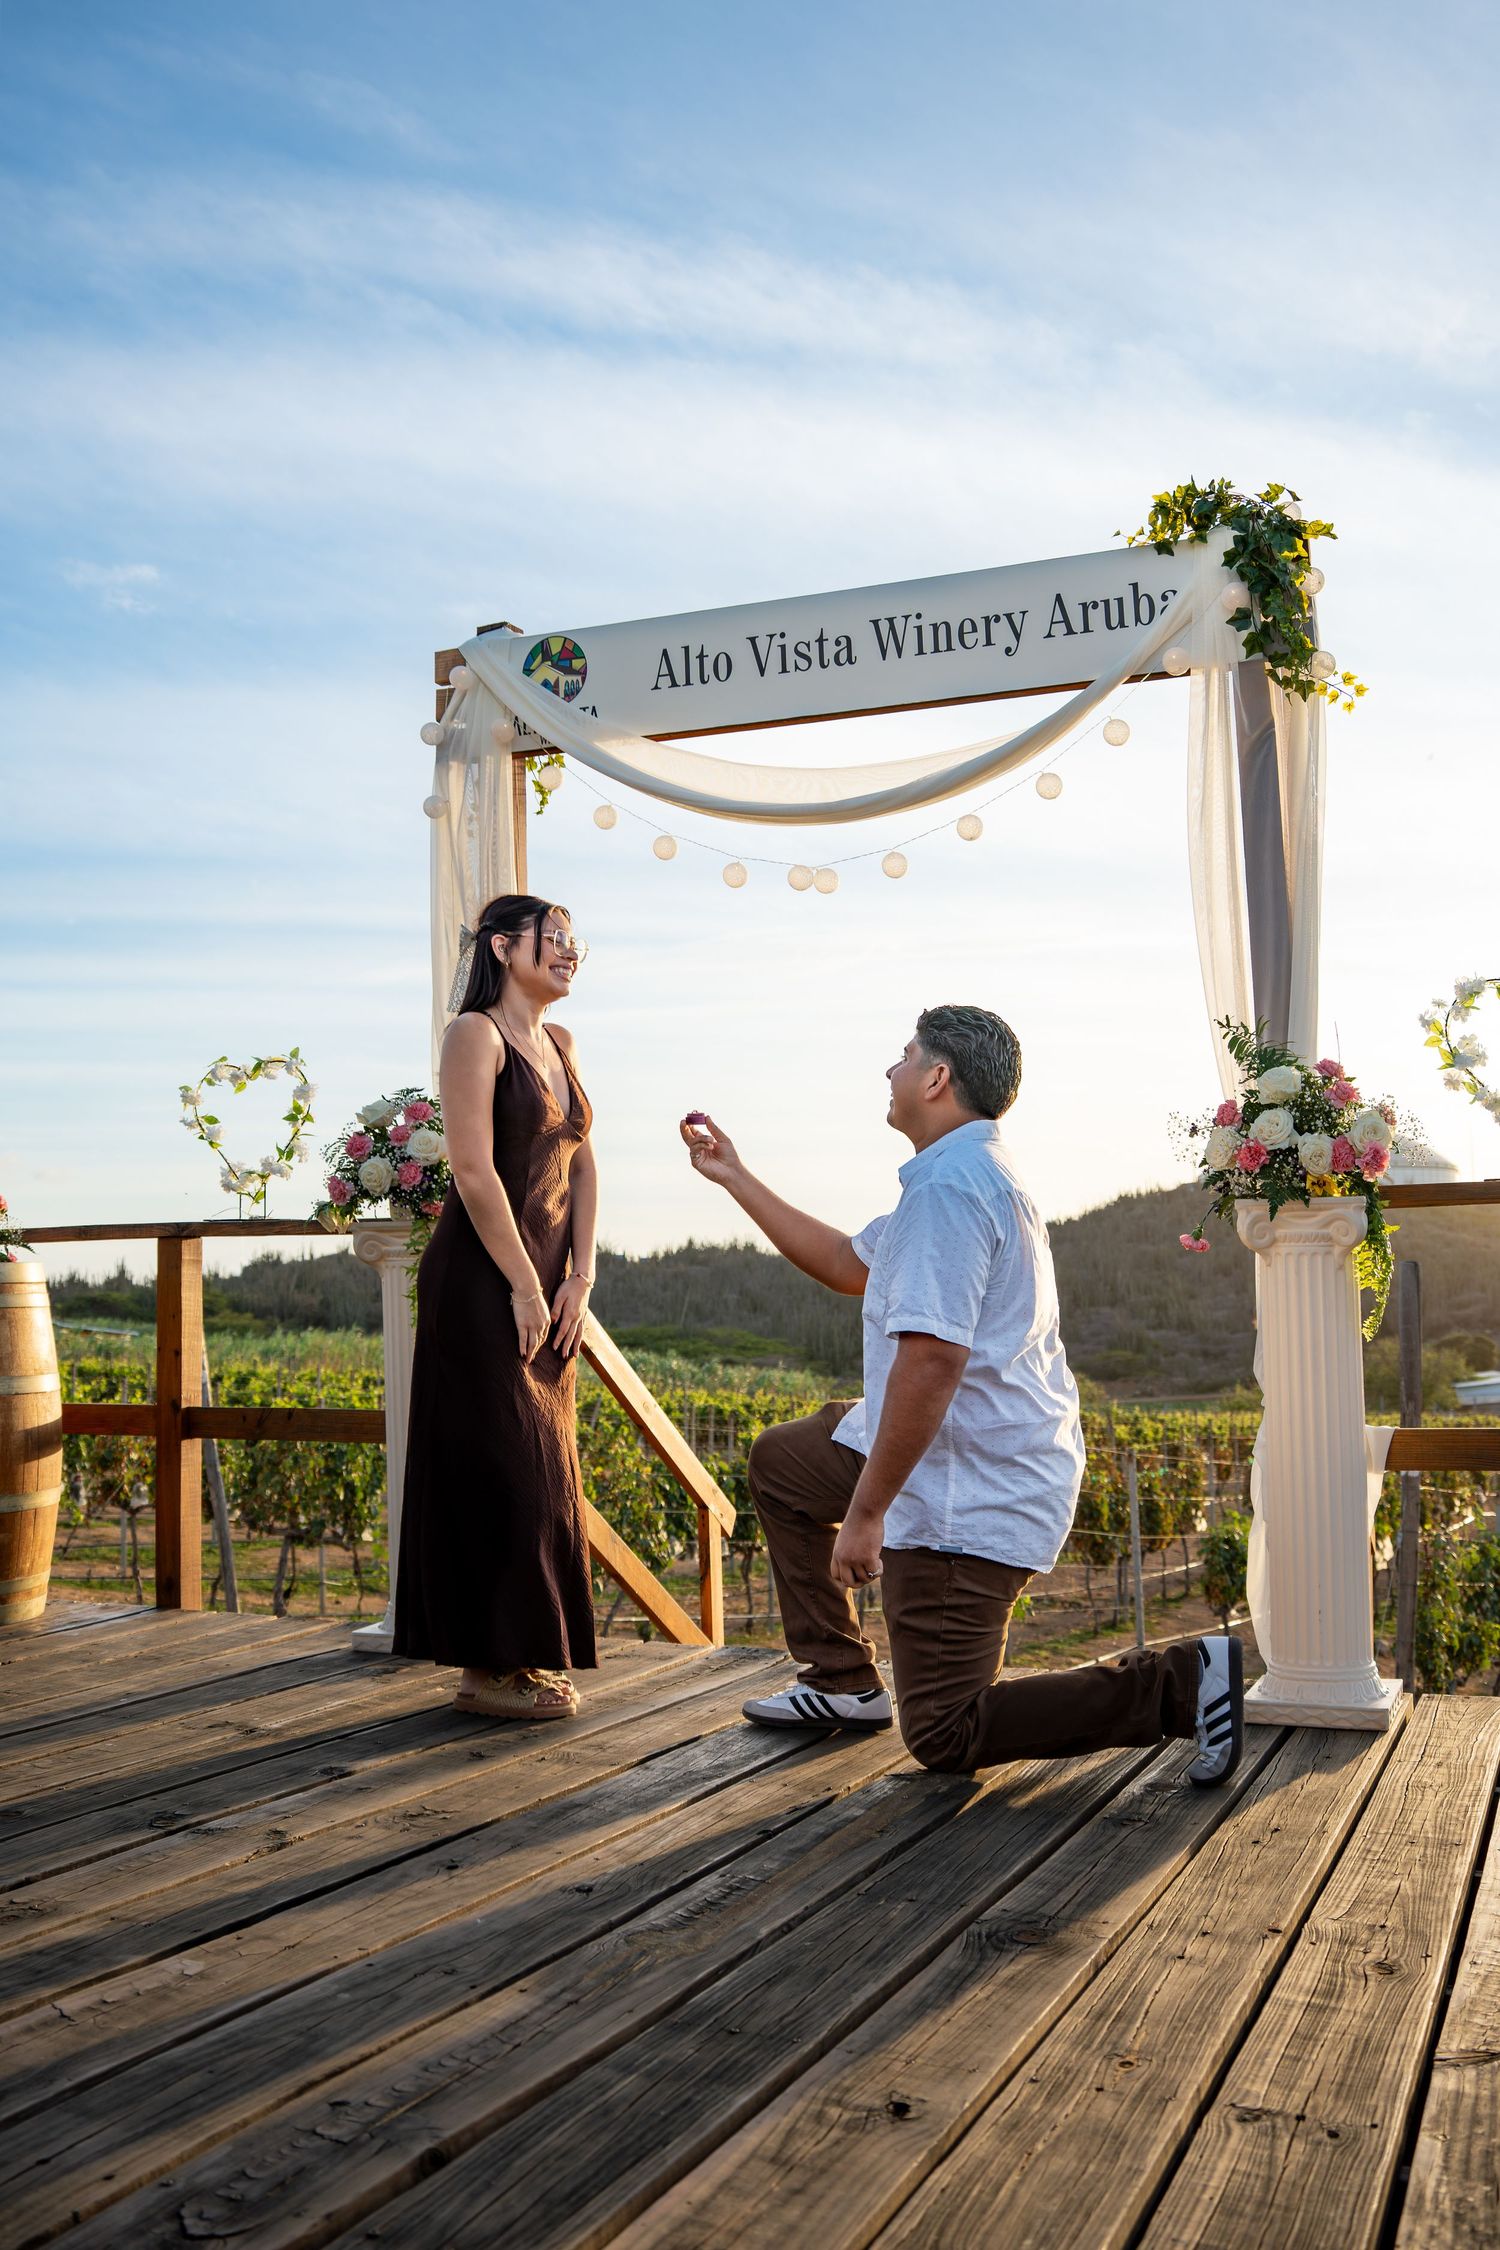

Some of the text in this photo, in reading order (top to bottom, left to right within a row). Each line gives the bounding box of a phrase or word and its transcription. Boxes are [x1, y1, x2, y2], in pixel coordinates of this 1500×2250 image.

[650, 643, 733, 691] Alto
[745, 627, 857, 678] Vista
[868, 611, 1029, 662] Winery
